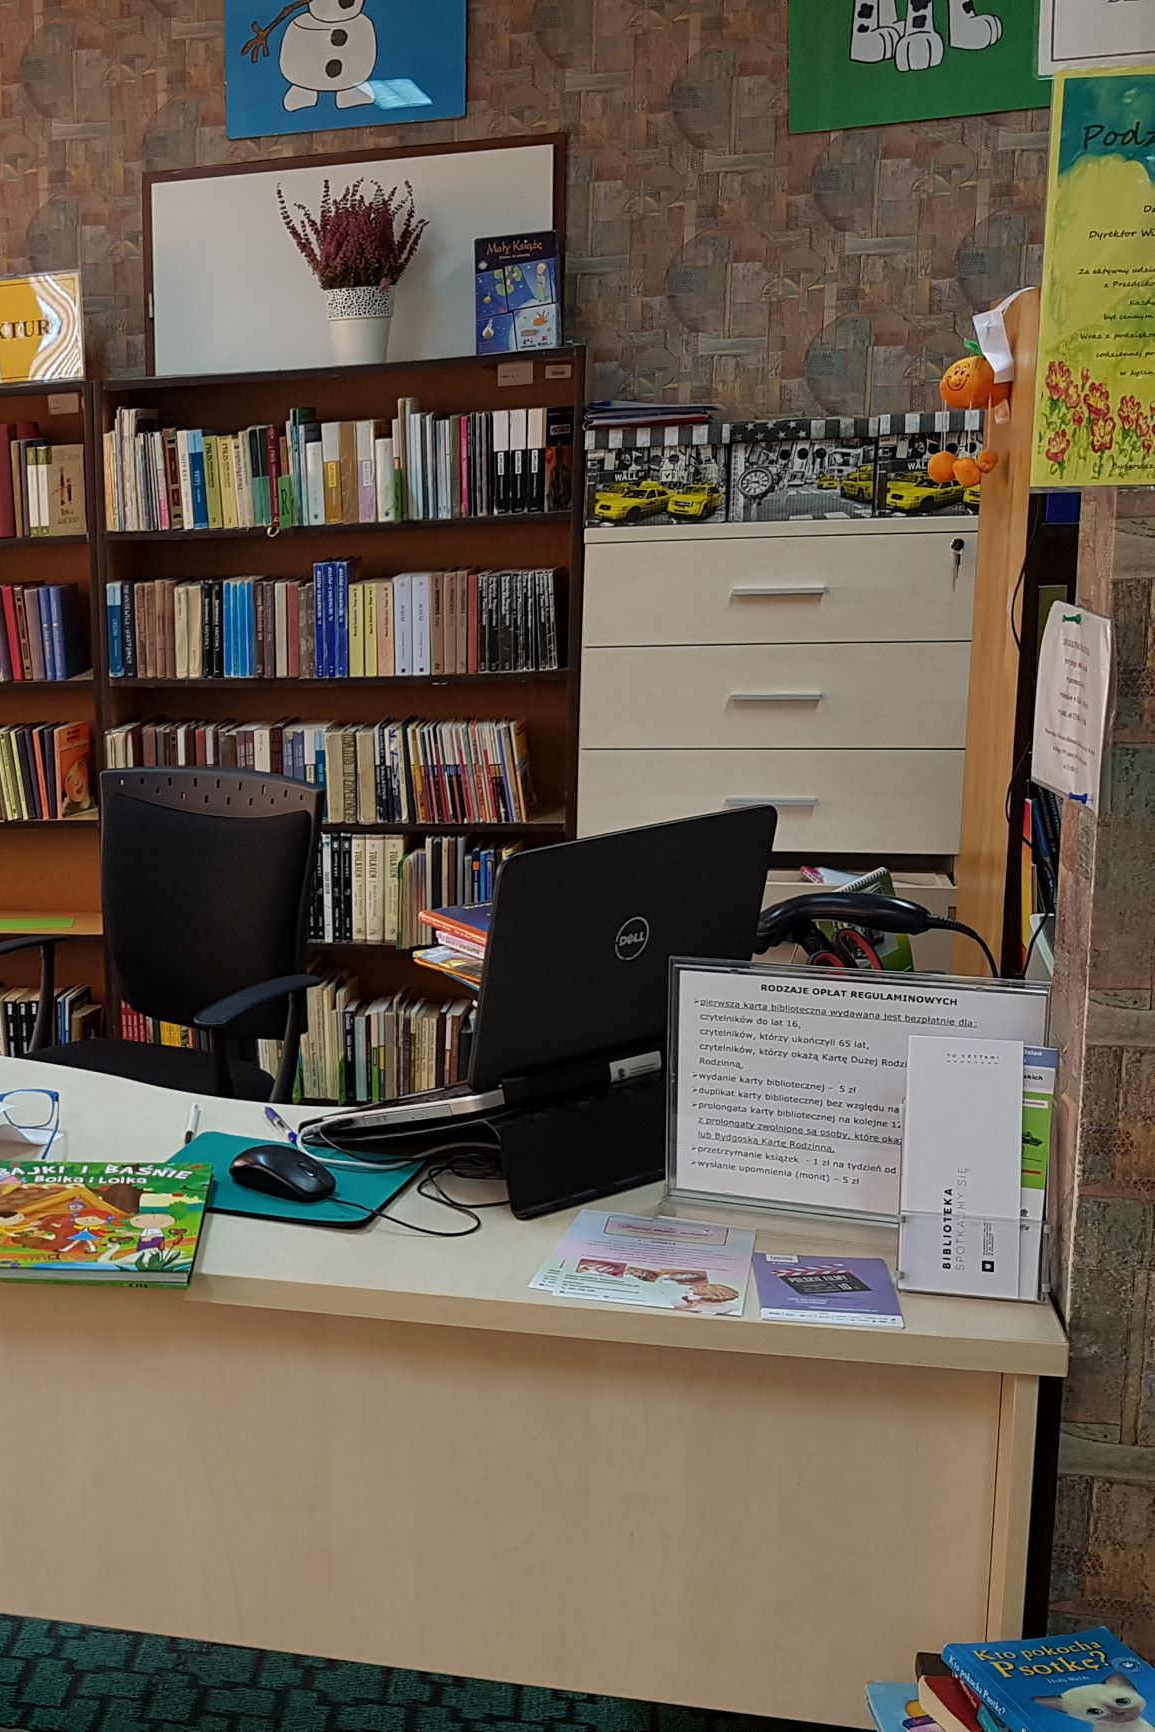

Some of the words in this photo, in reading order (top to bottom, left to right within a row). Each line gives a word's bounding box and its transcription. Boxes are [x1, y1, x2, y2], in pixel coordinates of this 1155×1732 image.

[1089, 230, 1136, 240] Dyrektor
[486, 241, 510, 256] Mały
[512, 240, 543, 251] Książę
[614, 470, 638, 482] WALL
[907, 461, 927, 470] WAL
[280, 488, 290, 516] R
[354, 850, 363, 878] TOLKIEN
[368, 852, 378, 878] TOLKIEN
[390, 850, 398, 878] TOLKIEN
[619, 931, 644, 947] DELL
[760, 984, 809, 994] RODZAJE
[812, 988, 847, 997] OPŁAT
[850, 990, 958, 1006] REGULAMINOWYCH
[700, 999, 740, 1008] pierwsza
[744, 1002, 768, 1011] karta
[771, 1004, 826, 1016] biblioteczna
[830, 1009, 880, 1021] wydawana
[883, 1012, 901, 1022] jest
[905, 1015, 955, 1026] bezpłatnie
[958, 1019, 977, 1028] dla:
[700, 1013, 753, 1024] czytelników
[788, 1020, 801, 1029] 16,
[700, 1028, 755, 1040] czytelników,
[759, 1033, 788, 1043] którzy
[792, 1036, 835, 1047] ukończyli
[839, 1039, 850, 1047] 65
[854, 1040, 869, 1050] lat,
[699, 1043, 755, 1055] czytelników,
[759, 1048, 788, 1058] którzy
[791, 1051, 819, 1062] okażą
[822, 1054, 847, 1064] Kartę
[851, 1055, 878, 1067] Dużej
[700, 1057, 744, 1069] Rodzinną,
[699, 1074, 736, 1082] wydanie
[739, 1076, 763, 1086] karty
[766, 1078, 825, 1092] bibliotecznej
[698, 1087, 734, 1097] duplikat
[738, 1091, 762, 1100] karty
[765, 1094, 823, 1107] bibliotecznej
[826, 1099, 842, 1107] bez
[846, 1102, 884, 1112] względu
[698, 1102, 747, 1112] prolongata
[750, 1107, 774, 1116] karty
[777, 1110, 835, 1123] bibliotecznej
[854, 1117, 888, 1127] kolejne
[698, 1130, 711, 1138] lub
[715, 1132, 758, 1144] Bydgoską
[762, 1138, 786, 1148] Kartę
[789, 1140, 834, 1153] Rodzinną,
[706, 1118, 754, 1129] prolongaty
[758, 1124, 803, 1134] zwolnione
[820, 1130, 850, 1140] osoby,
[854, 1133, 879, 1142] które
[698, 1146, 762, 1159] przetrzymanie
[766, 1153, 799, 1163] książek
[848, 1162, 882, 1172] tydzień
[34, 1175, 85, 1184] Bolka
[98, 1176, 147, 1184] Lolka
[82, 1165, 88, 1174] I
[105, 1164, 193, 1180] BAŚNIE
[698, 1160, 736, 1170] wysłanie
[739, 1166, 792, 1176] upomnienia
[796, 1170, 830, 1182] (monit)
[942, 1188, 953, 1270] BIBLIOTEKA
[956, 1194, 967, 1271] SPOTKAJMY
[974, 1649, 1017, 1661] Kto
[1022, 1640, 1102, 1661] pokocha
[990, 1652, 1110, 1679] Psotkę?
[949, 1655, 960, 1673] Kto
[960, 1670, 983, 1695] pokocha
[982, 1689, 1006, 1715] Psotkę?
